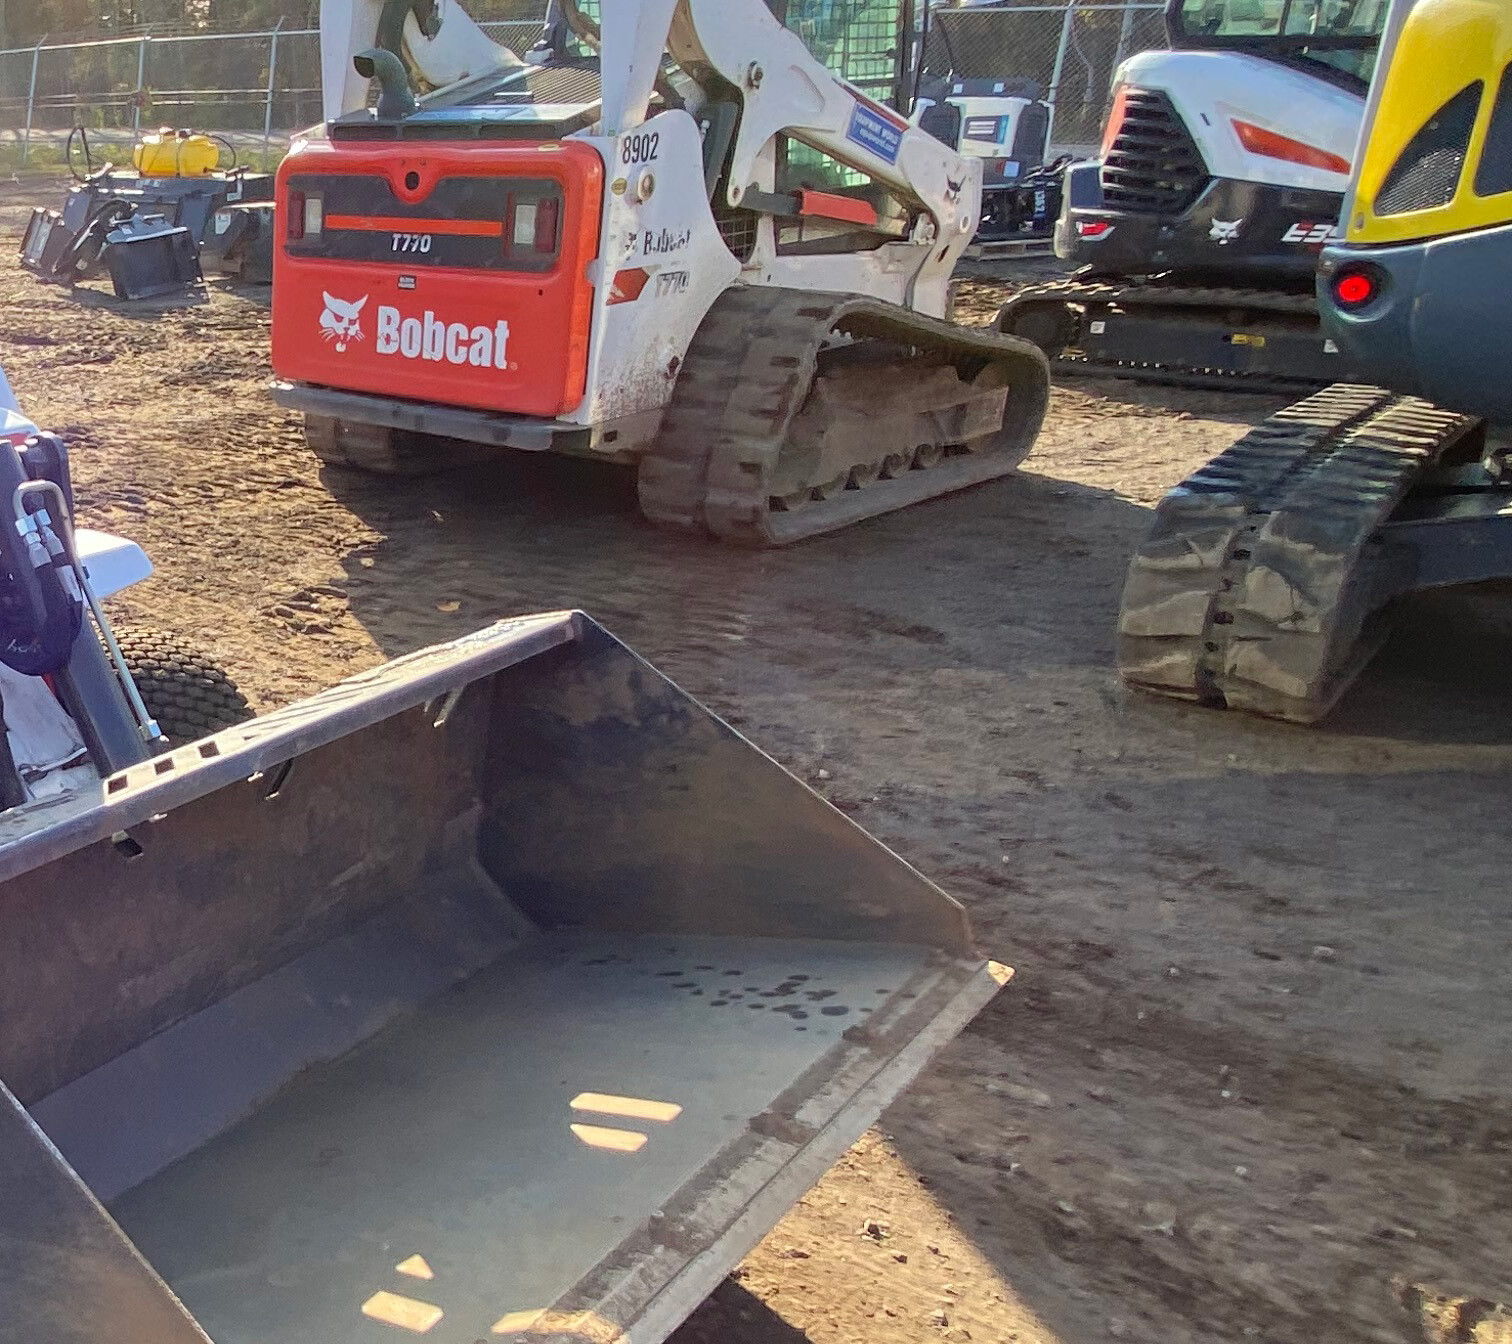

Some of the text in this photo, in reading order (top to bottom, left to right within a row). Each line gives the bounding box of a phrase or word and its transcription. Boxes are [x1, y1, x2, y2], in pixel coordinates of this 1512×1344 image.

[622, 132, 659, 164] 8902
[391, 233, 432, 253] T770
[376, 305, 510, 370] Bobcat
